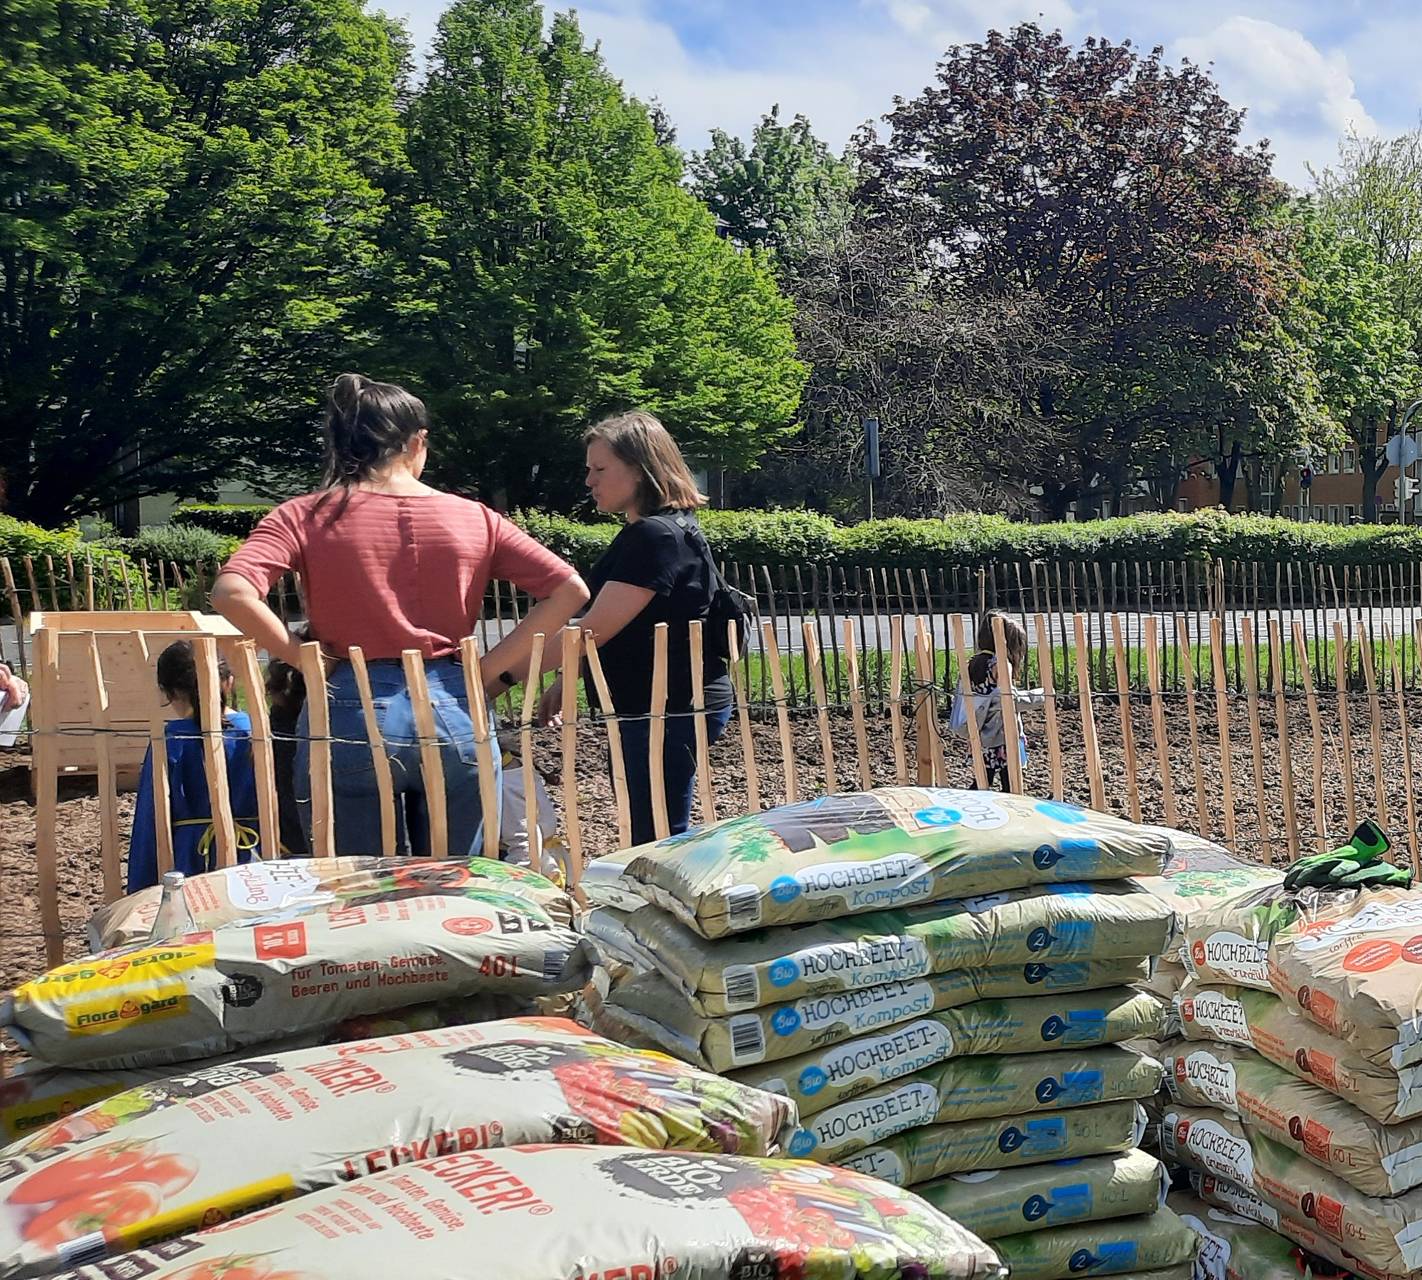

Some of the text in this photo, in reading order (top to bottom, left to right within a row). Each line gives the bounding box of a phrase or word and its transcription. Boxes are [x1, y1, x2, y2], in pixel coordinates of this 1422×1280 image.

[1040, 851, 1051, 865] 2
[801, 859, 915, 893] HOCHBEET-
[852, 878, 929, 907] Kompost
[1033, 934, 1045, 947] 2
[802, 941, 914, 977] HOCHBEET-
[1030, 965, 1040, 977] 2
[292, 970, 449, 998] Beeren und Hochbeete
[77, 996, 179, 1026] Flora gard
[854, 993, 931, 1030] Kompost
[1048, 1023, 1057, 1036] 2
[826, 1026, 937, 1083] HOCHBEET-
[879, 1040, 950, 1082] Kompost
[1042, 1082, 1053, 1098] 2
[817, 1089, 930, 1143] HOCHBEET-
[1005, 1133, 1016, 1148] 2
[622, 1158, 704, 1197] ERDE
[1030, 1201, 1041, 1216] 2
[1076, 1255, 1087, 1269] 2
